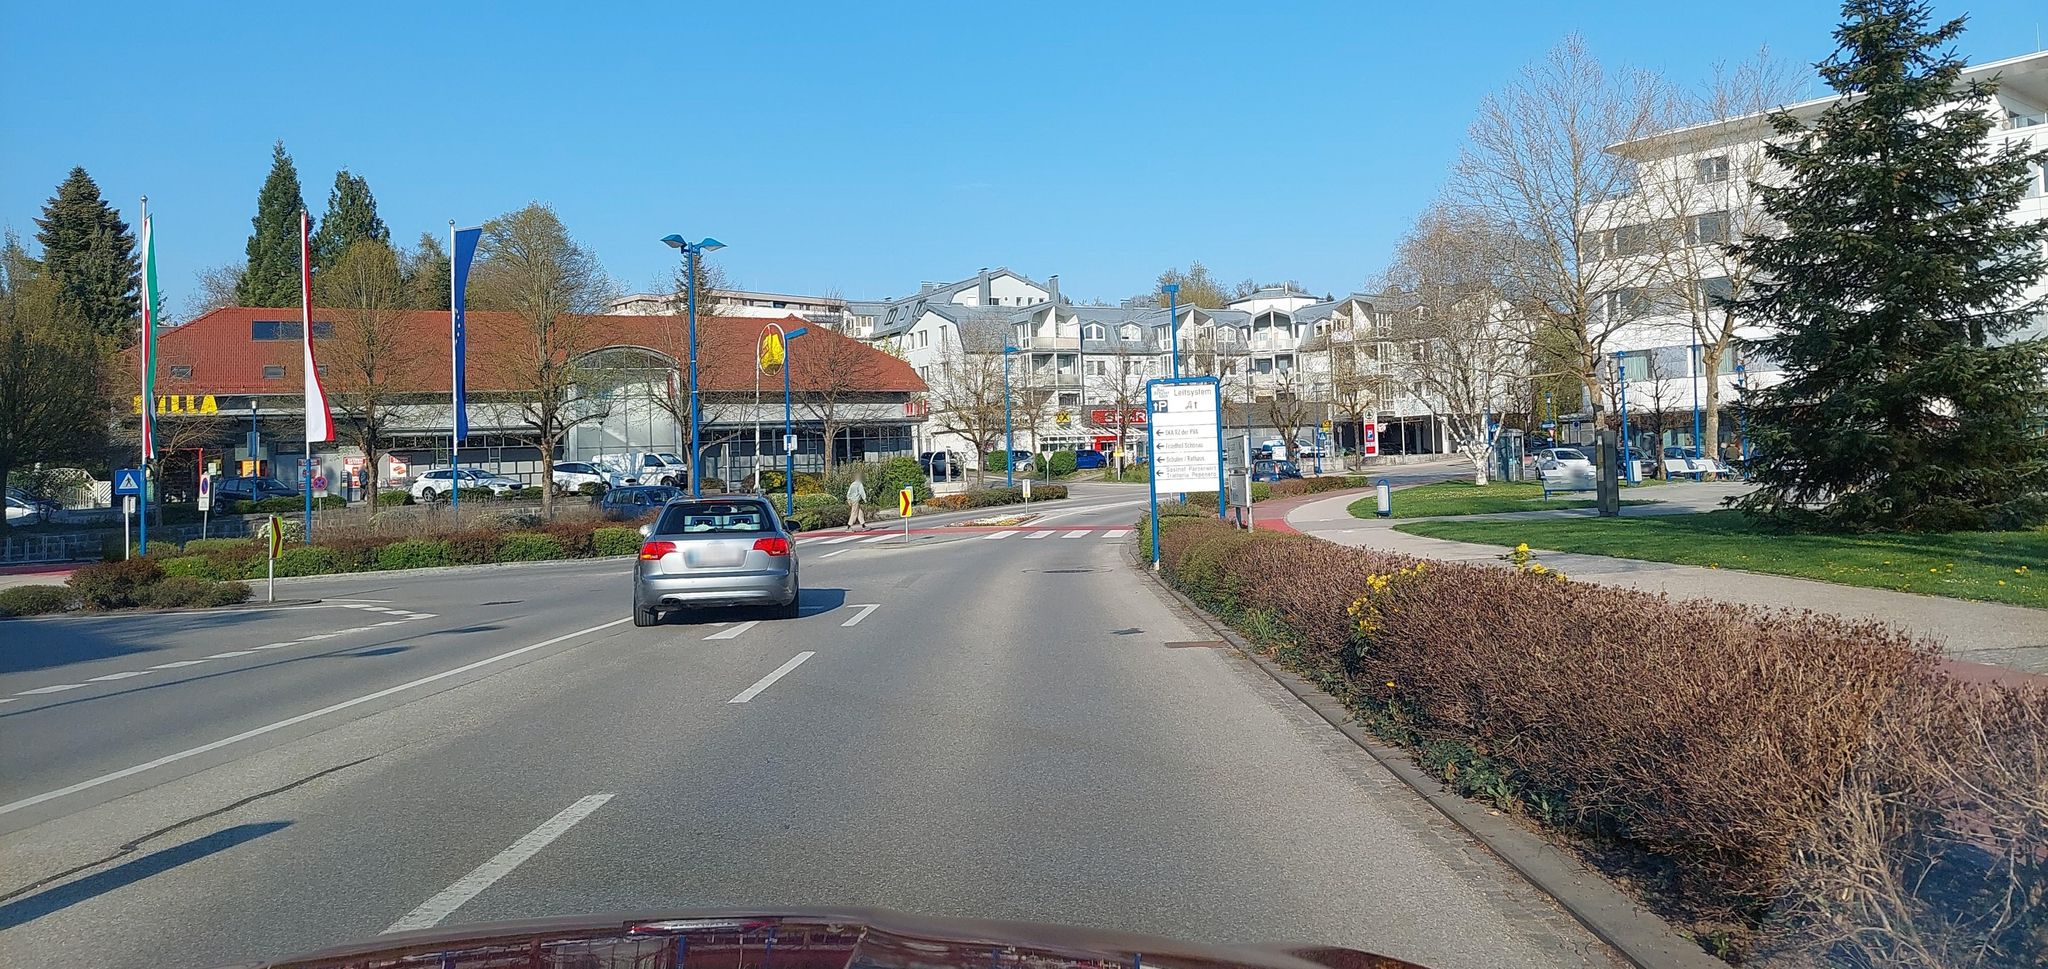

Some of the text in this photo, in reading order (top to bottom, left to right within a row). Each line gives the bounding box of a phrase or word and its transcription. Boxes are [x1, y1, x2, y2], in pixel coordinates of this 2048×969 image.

[1173, 388, 1212, 397] Leitsystem
[1158, 401, 1167, 411] P
[1104, 411, 1146, 422] SPR
[1187, 454, 1204, 462] Rathaus
